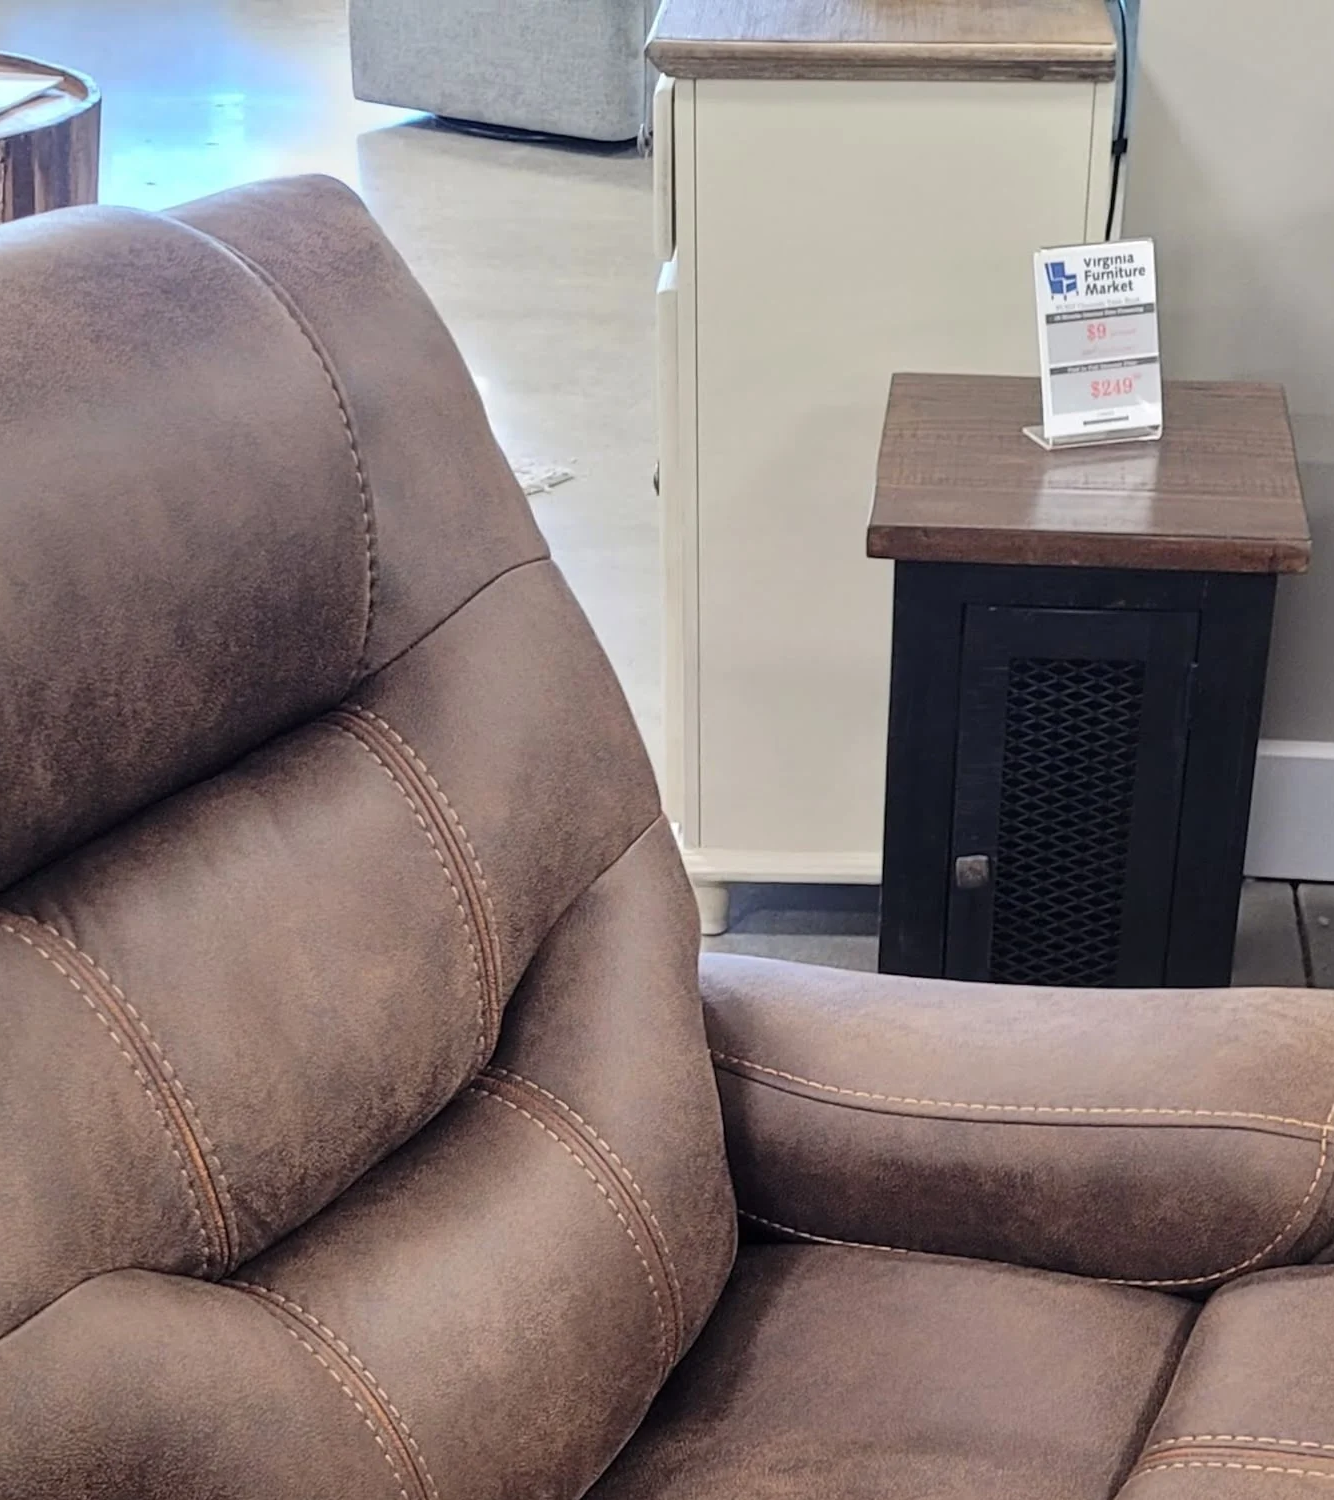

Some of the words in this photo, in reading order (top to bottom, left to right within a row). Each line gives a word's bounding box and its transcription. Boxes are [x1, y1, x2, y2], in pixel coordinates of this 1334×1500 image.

[1083, 254, 1135, 269] Virginia
[1084, 266, 1146, 282] Furniture
[1085, 280, 1134, 296] Market
[1087, 323, 1107, 342] $9
[1090, 377, 1133, 399] $249
